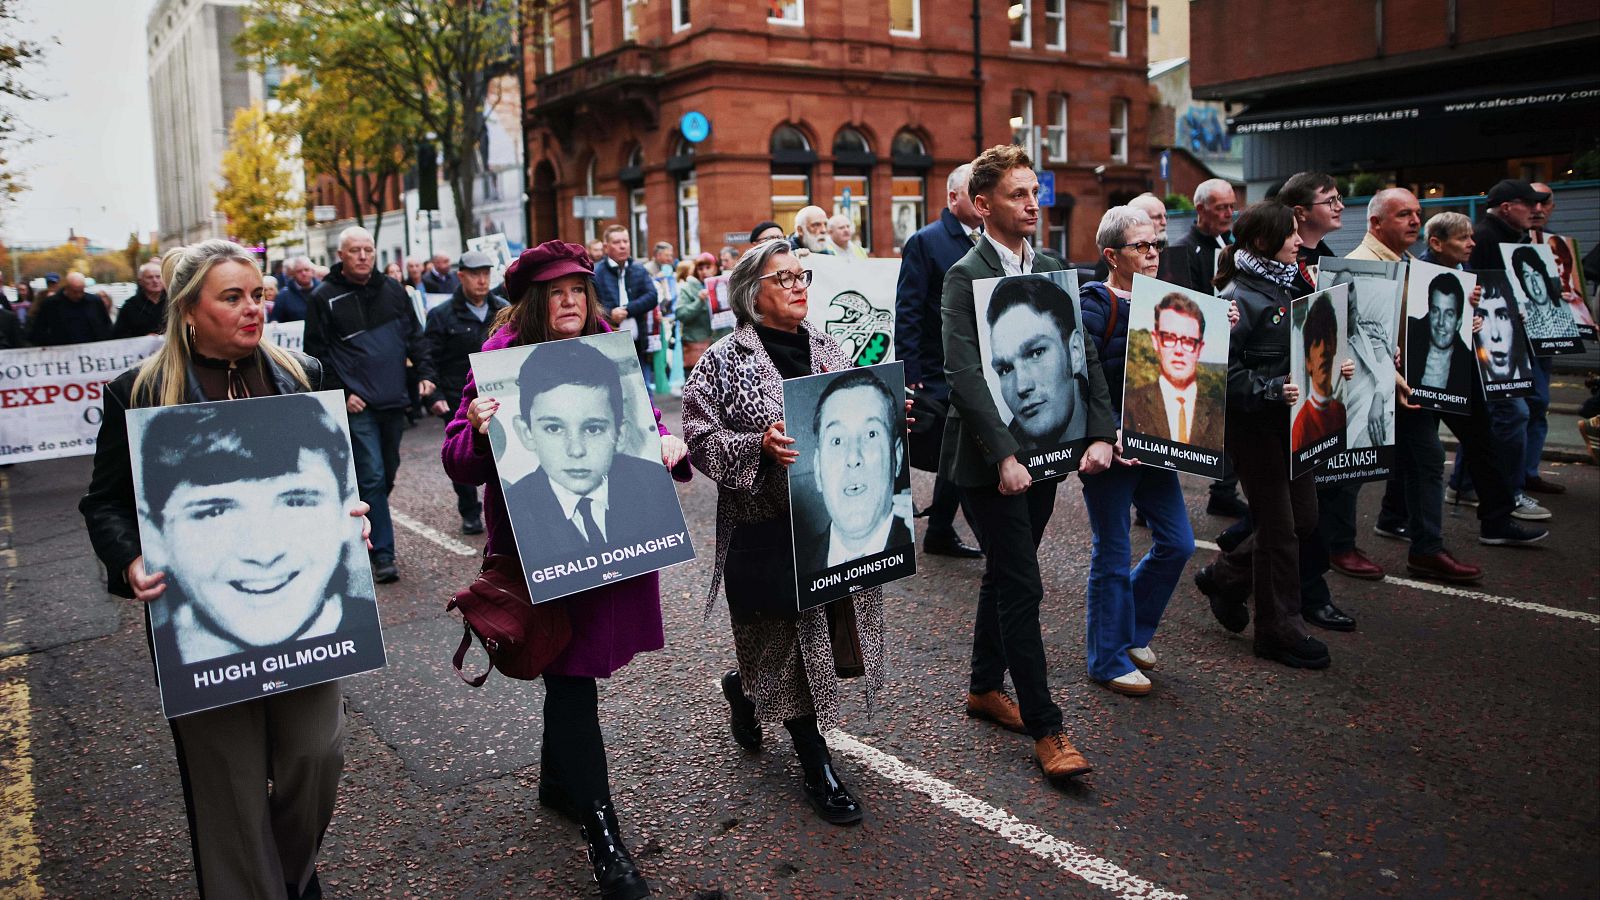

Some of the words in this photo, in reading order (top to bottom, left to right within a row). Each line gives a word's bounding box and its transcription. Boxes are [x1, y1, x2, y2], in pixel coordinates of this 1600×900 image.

[1236, 121, 1281, 134] OUTSIDE
[1283, 116, 1339, 130] CATERING
[1342, 108, 1419, 125] SPECIALISTS
[79, 350, 155, 373] BELFA
[0, 380, 110, 409] EXPOS
[1411, 388, 1437, 400] PATRICK
[1438, 392, 1468, 405] DOHERTY
[1486, 383, 1500, 391] KEVIN
[0, 444, 34, 456] llets
[38, 441, 55, 451] do
[60, 438, 82, 448] not
[1028, 455, 1044, 468] JIM
[1045, 447, 1073, 463] WRAY
[1127, 437, 1168, 455] WILLIAM
[1170, 446, 1219, 466] McKINNEY
[1300, 443, 1323, 462] WILLIAM
[1323, 436, 1338, 450] NASH
[1327, 452, 1350, 469] ALEX
[1352, 450, 1377, 467] NASH
[1314, 475, 1325, 483] Shot
[1325, 474, 1337, 484] going
[532, 556, 598, 583] GERALD
[601, 532, 685, 565] DONAGHEY
[810, 572, 841, 592] JOHN
[844, 554, 904, 581] JOHNSTON
[193, 661, 257, 688] HUGH
[262, 640, 357, 673] GILMOUR
